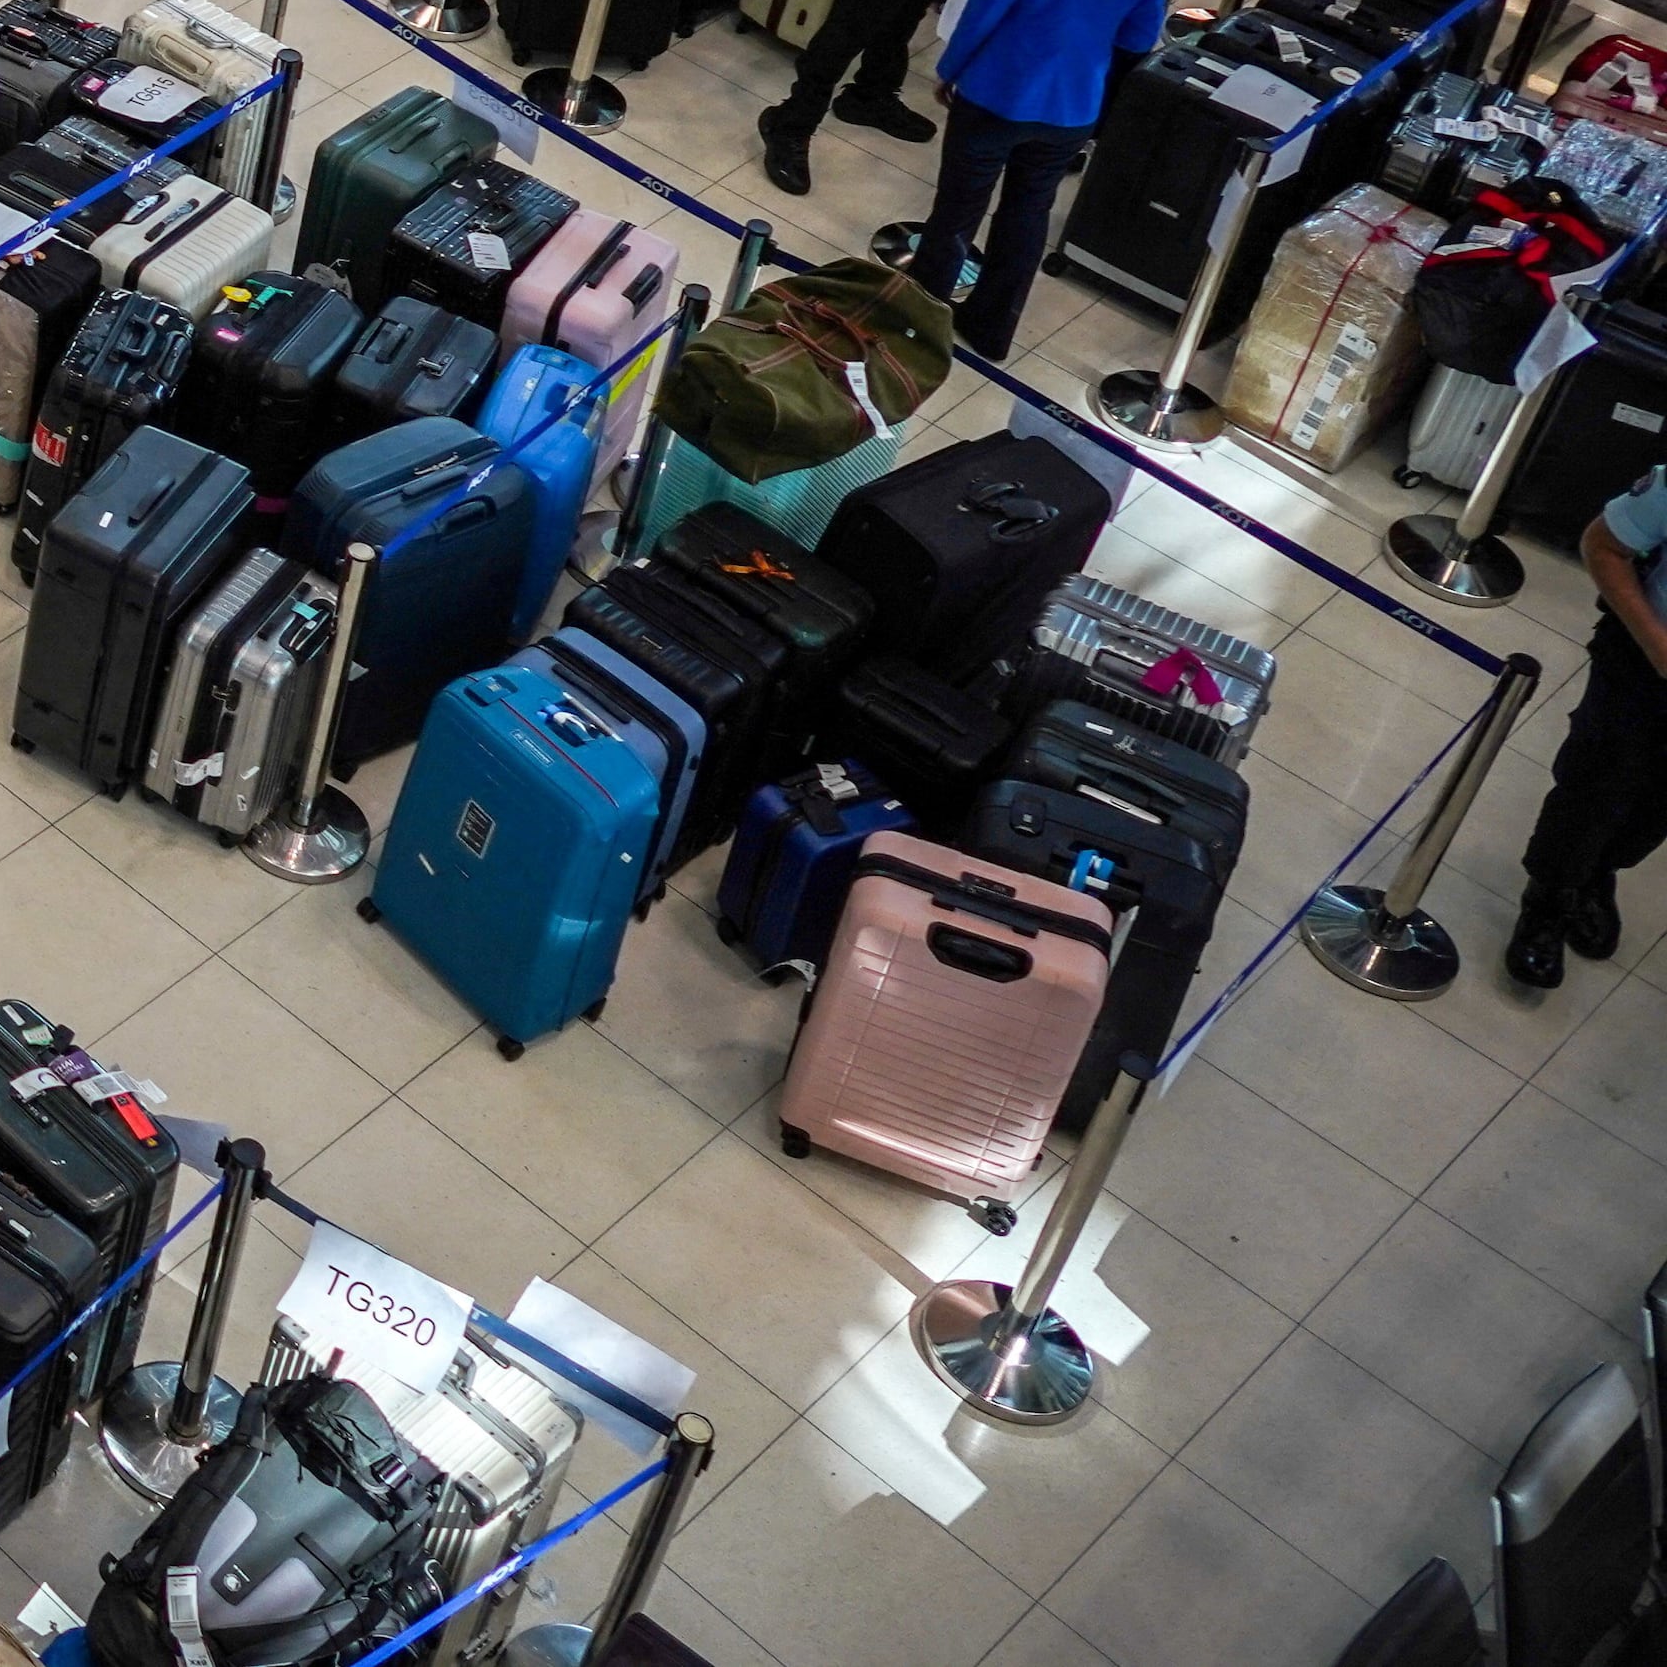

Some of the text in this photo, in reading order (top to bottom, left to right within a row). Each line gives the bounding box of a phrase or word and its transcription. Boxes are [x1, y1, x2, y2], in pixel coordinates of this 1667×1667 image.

[393, 23, 422, 44] AOT
[127, 77, 174, 107] TG615
[512, 100, 542, 120] AOT
[130, 155, 156, 174] AOT
[640, 175, 673, 197] AOT
[467, 465, 494, 491] AOT
[327, 1265, 436, 1347] TG320
[476, 1555, 522, 1592] AOT
